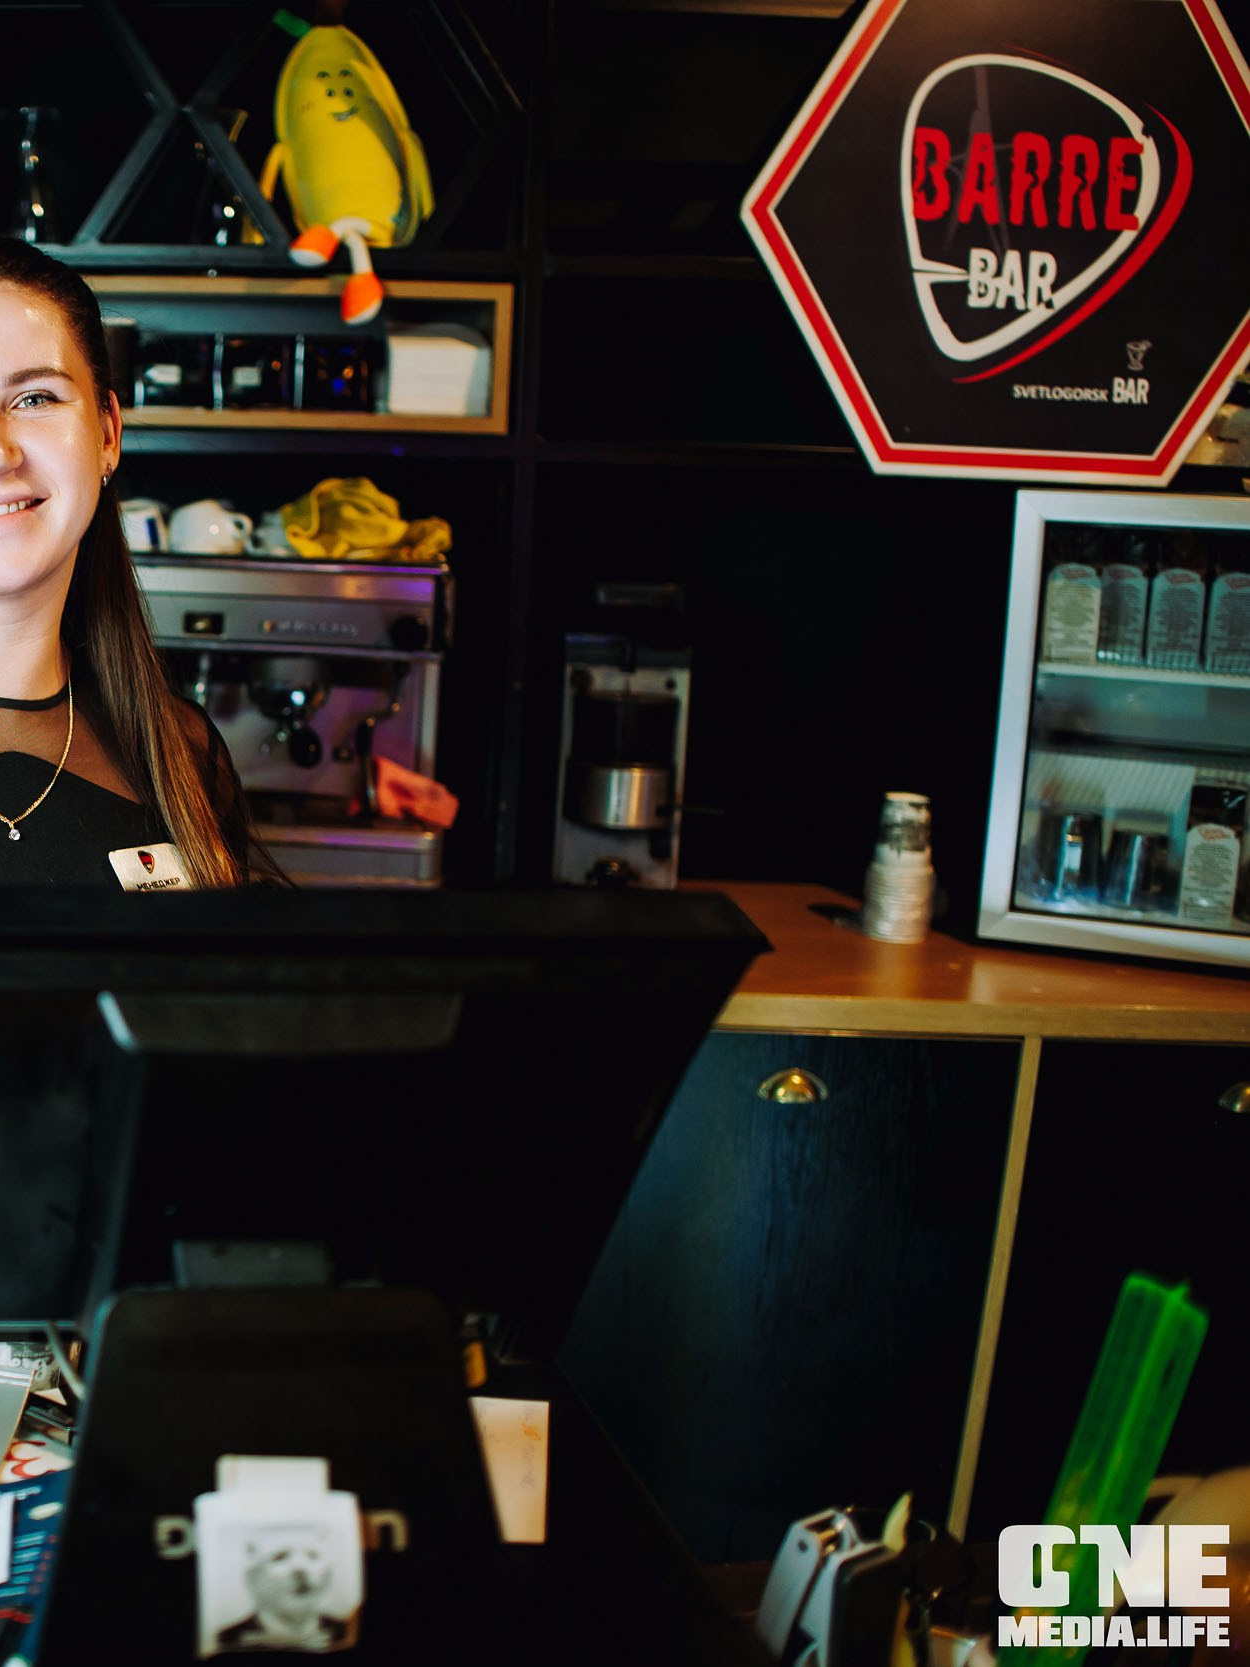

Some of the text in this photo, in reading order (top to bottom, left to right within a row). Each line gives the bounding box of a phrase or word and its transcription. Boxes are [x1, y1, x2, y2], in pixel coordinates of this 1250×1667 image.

[913, 126, 1144, 231] BARRE
[967, 247, 1058, 311] BAR
[1012, 376, 1150, 404] SVETLOGORSK BAR
[136, 877, 181, 891] МЕНЕДЖЕР
